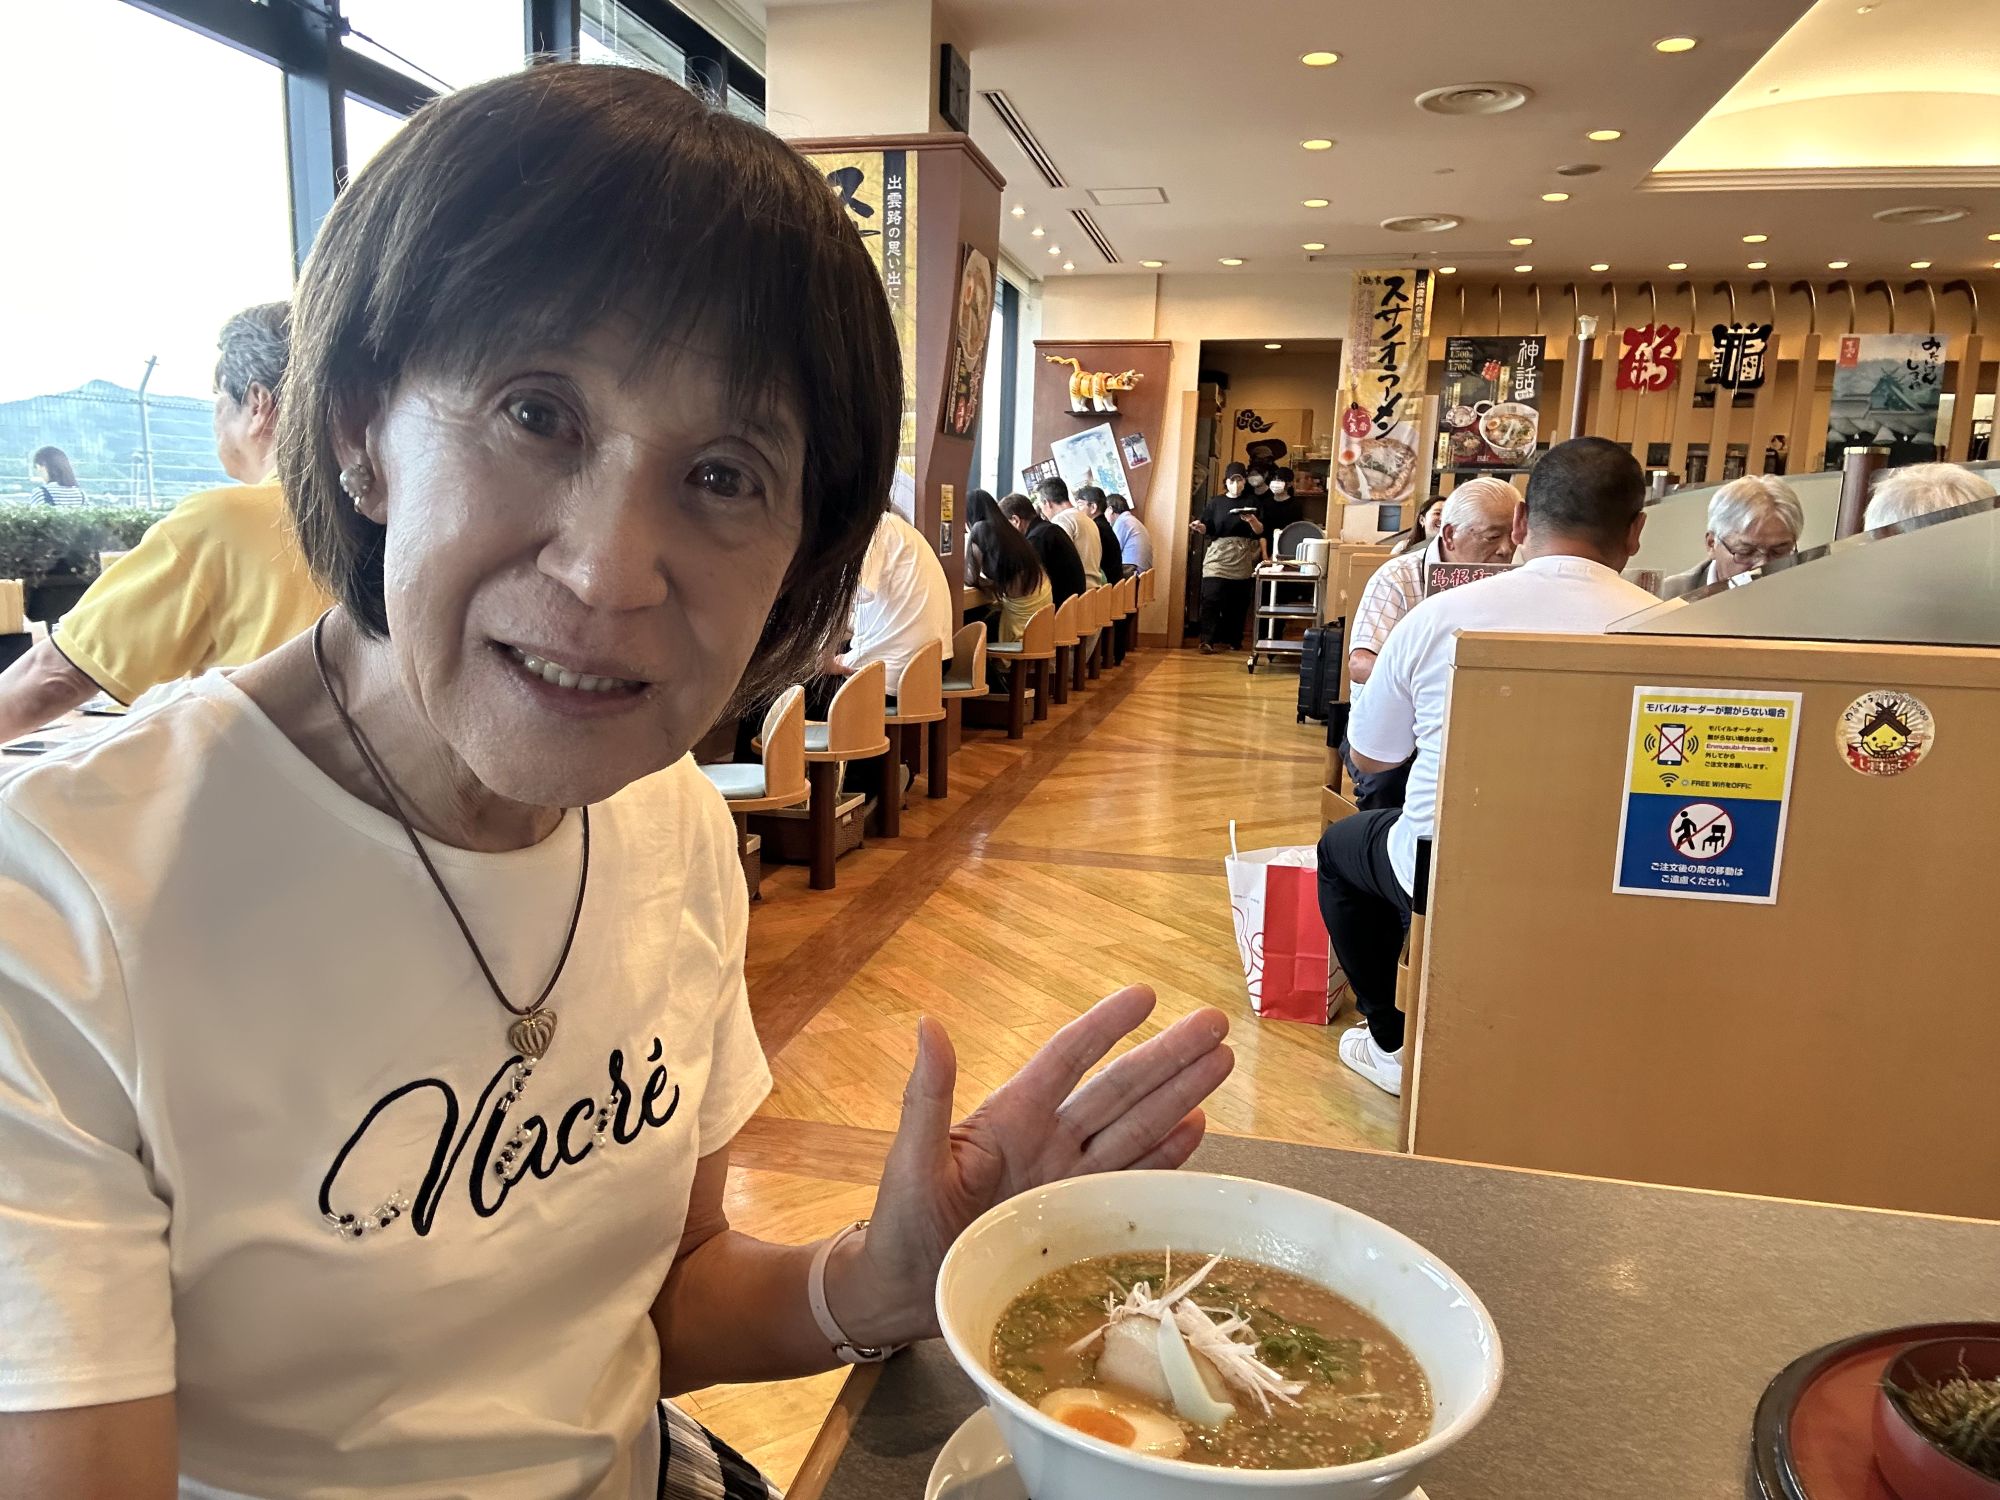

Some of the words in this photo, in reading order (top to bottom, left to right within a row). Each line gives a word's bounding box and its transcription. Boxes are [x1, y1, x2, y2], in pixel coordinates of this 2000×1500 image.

[1374, 276, 1412, 440] スサノオラーメン
[1516, 340, 1539, 389] 神話
[1650, 862, 1744, 876] ご注文後の席の移動は
[1661, 875, 1730, 887] ご遠慮ください。
[319, 1037, 680, 1237] Nacré
